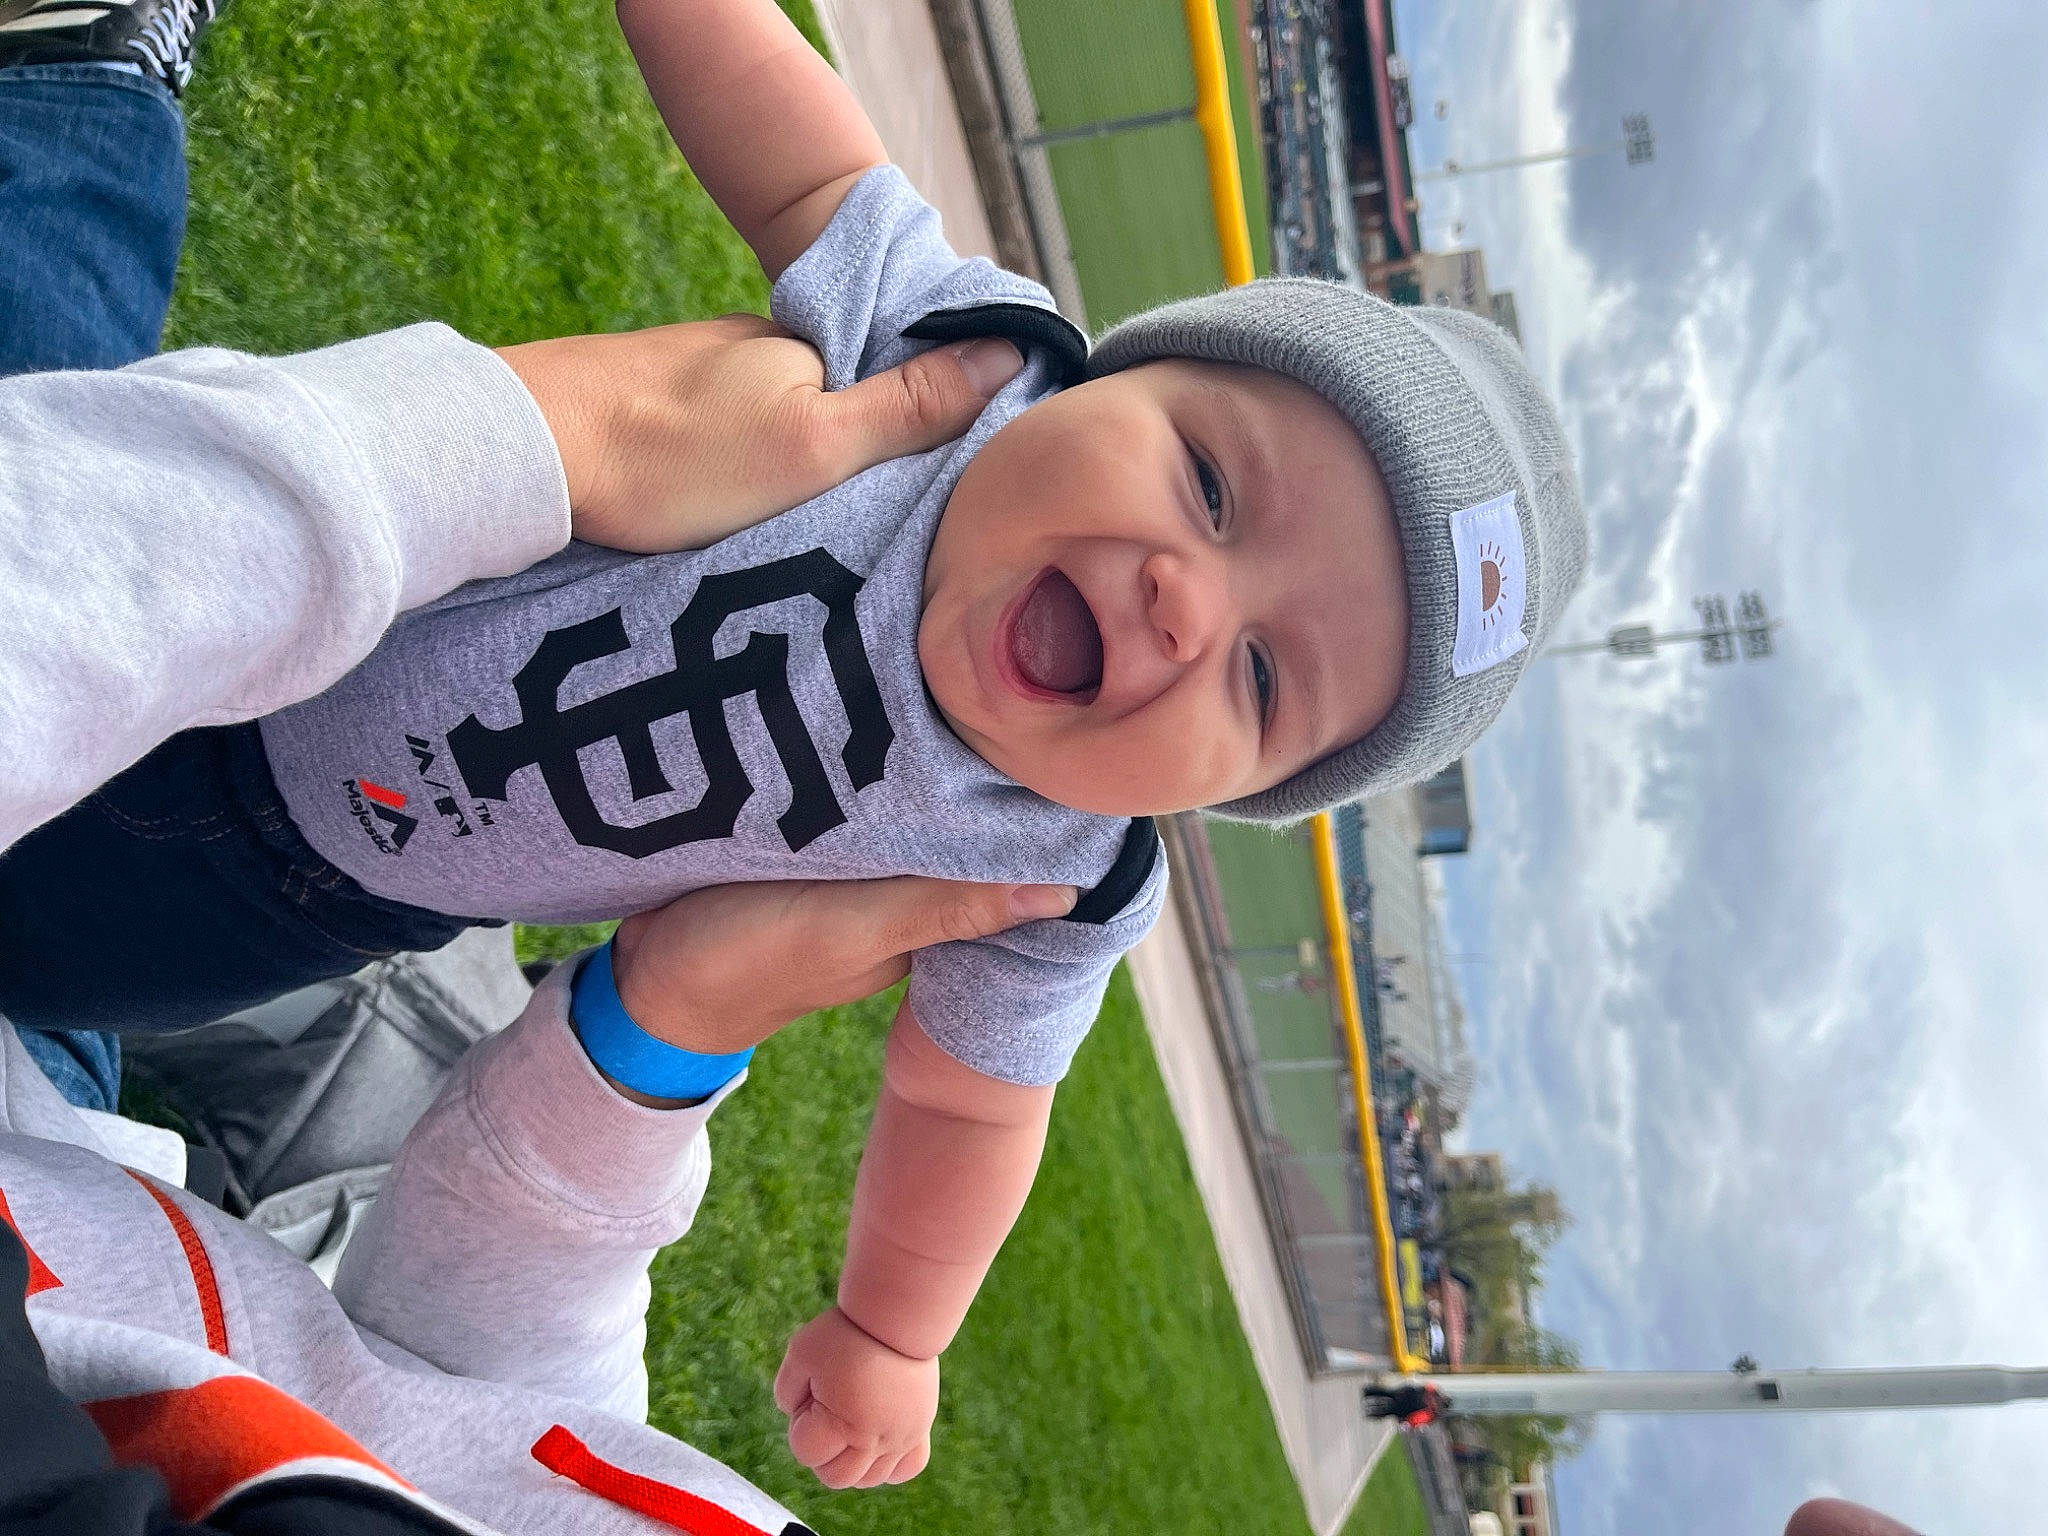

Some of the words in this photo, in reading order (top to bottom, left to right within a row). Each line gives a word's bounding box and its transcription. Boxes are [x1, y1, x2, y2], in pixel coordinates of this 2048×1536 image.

[446, 547, 895, 859] SF
[343, 779, 392, 854] Majestic
[474, 802, 495, 826] TM
